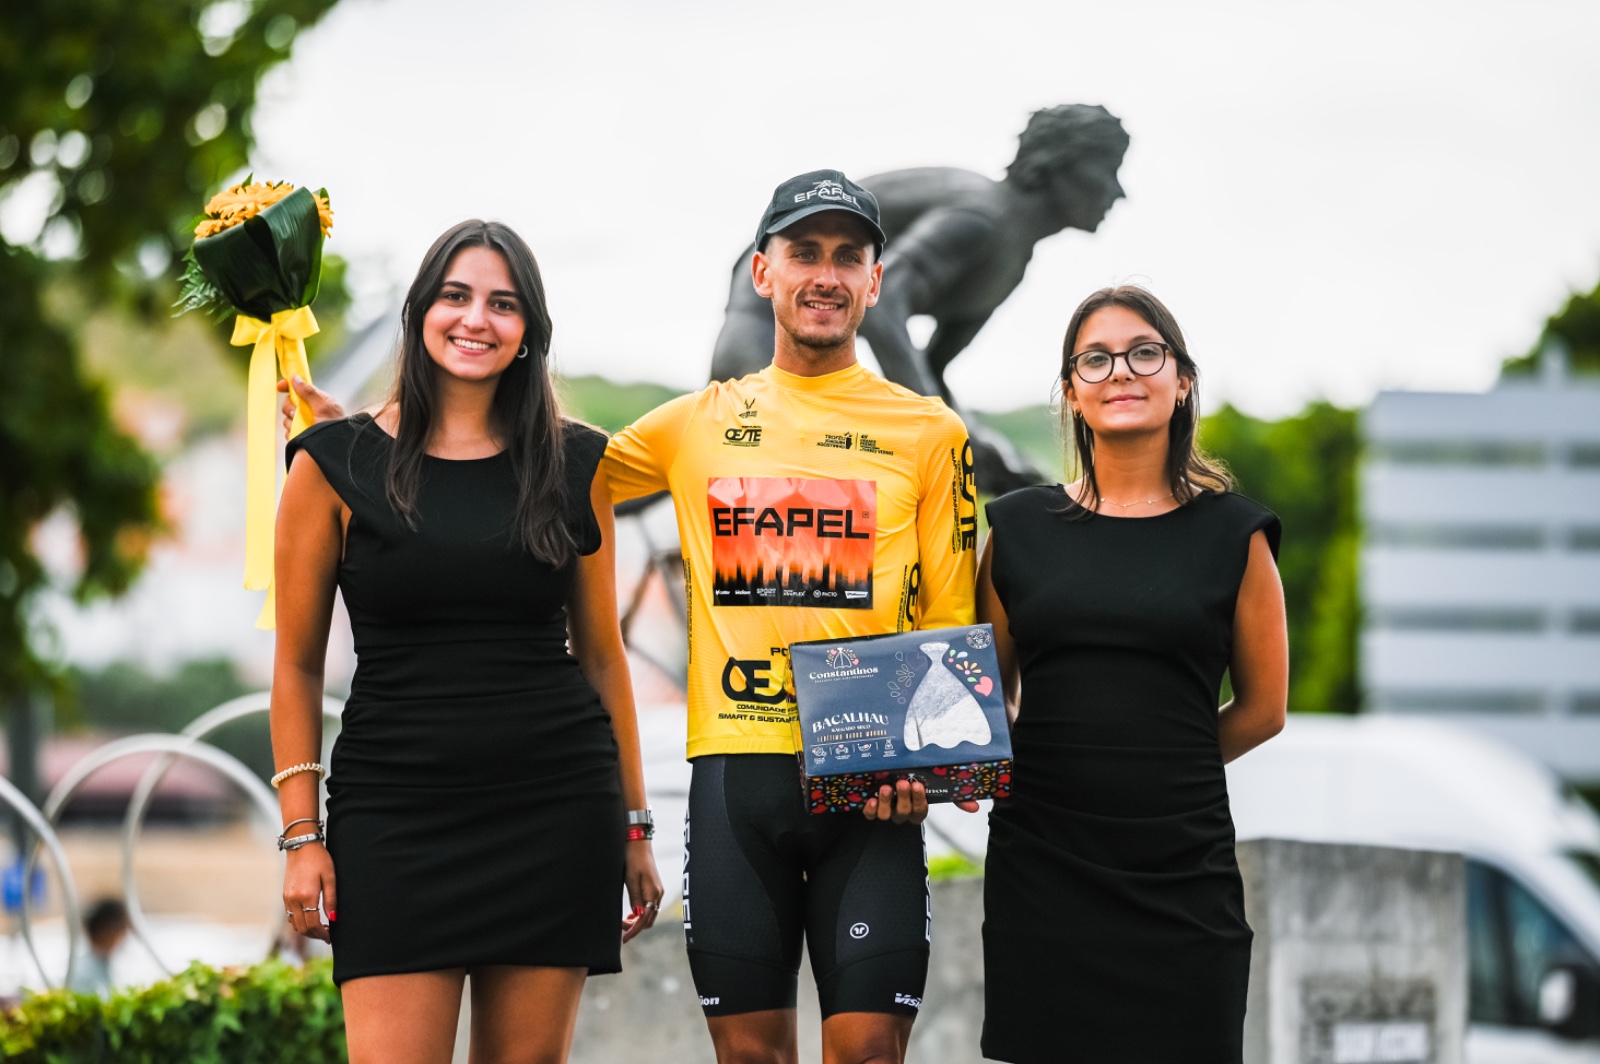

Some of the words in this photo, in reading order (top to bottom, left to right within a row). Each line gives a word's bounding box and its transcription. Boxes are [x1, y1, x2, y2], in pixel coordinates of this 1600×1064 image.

[794, 187, 861, 210] EFAPEL
[725, 428, 762, 441] OESTE
[712, 507, 870, 540] EFAPEL
[809, 667, 879, 680] Constantinos
[812, 711, 889, 733] BACALHAU
